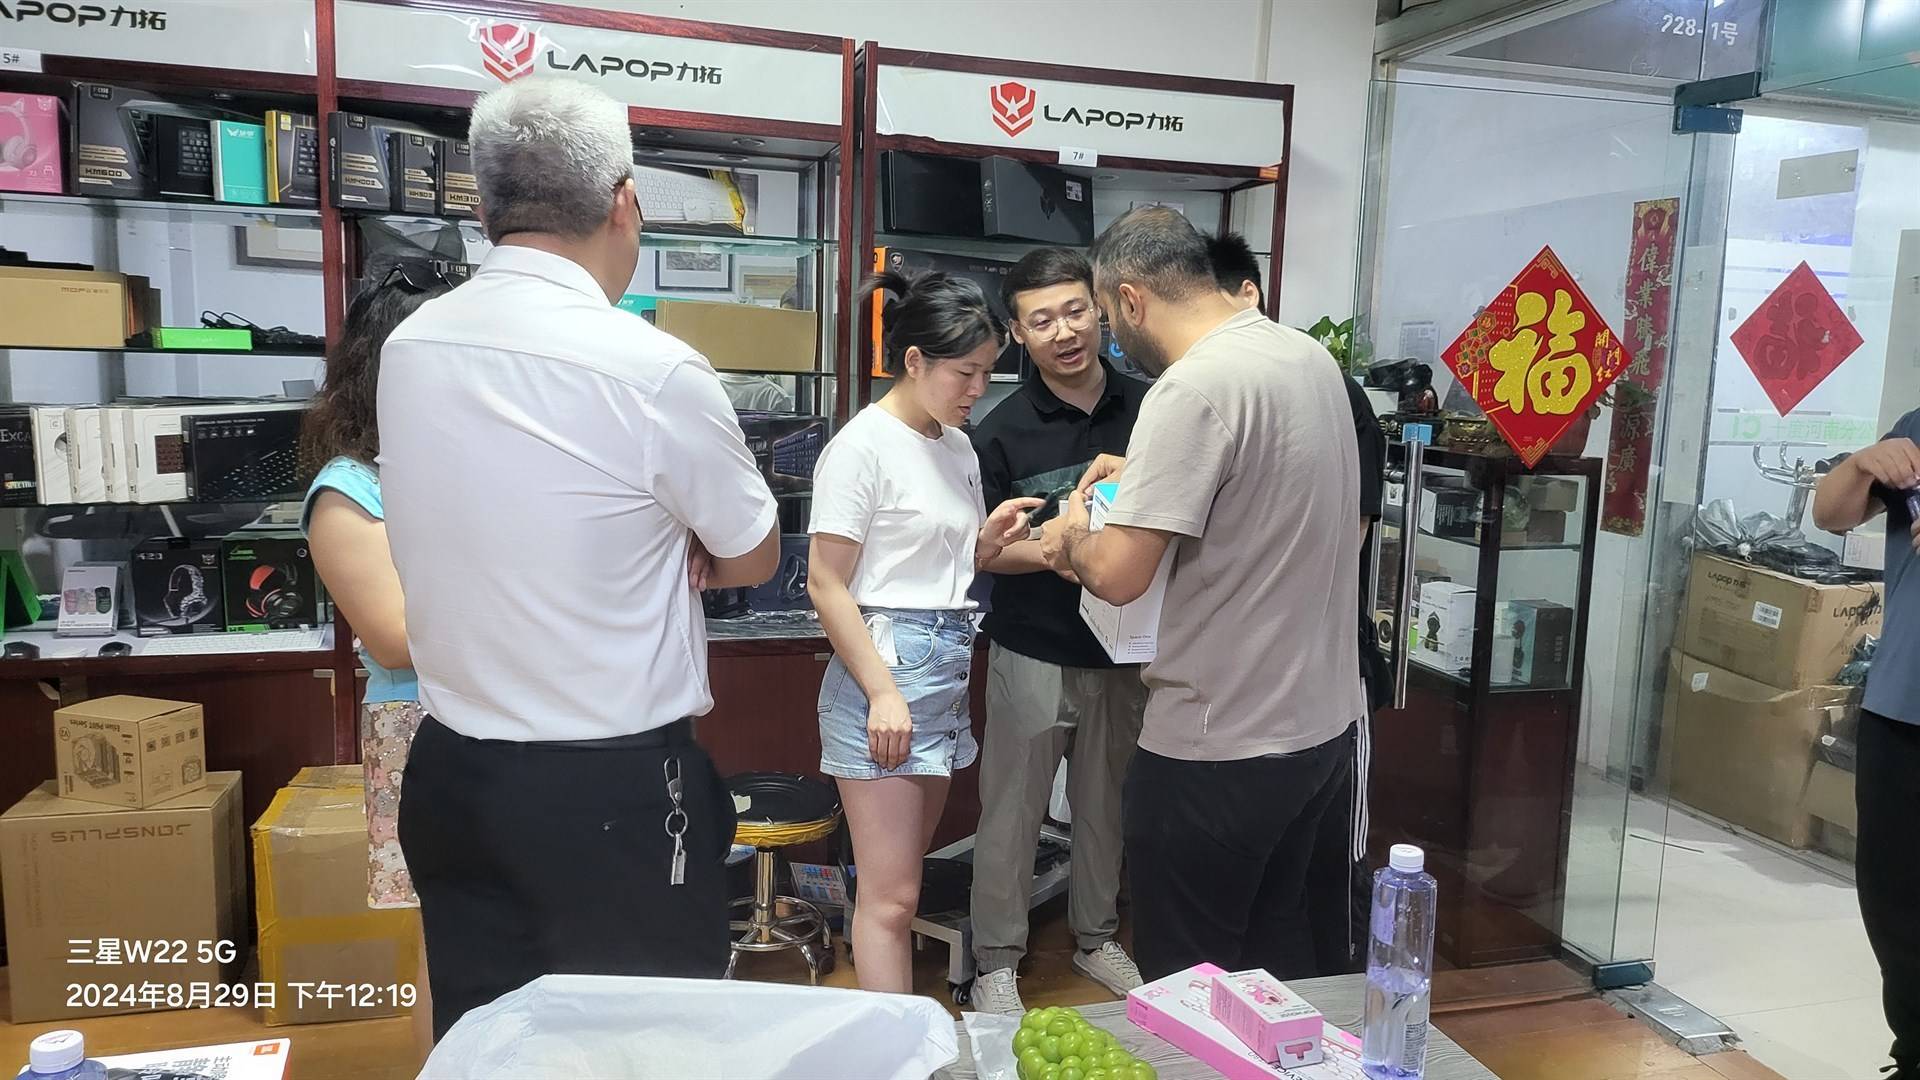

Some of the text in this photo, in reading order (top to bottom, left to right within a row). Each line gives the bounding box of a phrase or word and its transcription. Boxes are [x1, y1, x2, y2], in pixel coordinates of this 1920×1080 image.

[3, 53, 20, 64] 5#
[547, 50, 723, 85] LAPOP力拓
[1044, 105, 1184, 132] LAPOP力拓
[1073, 151, 1084, 160] 7#
[1489, 289, 1592, 415] 福
[50, 823, 192, 842] JONSPLUS
